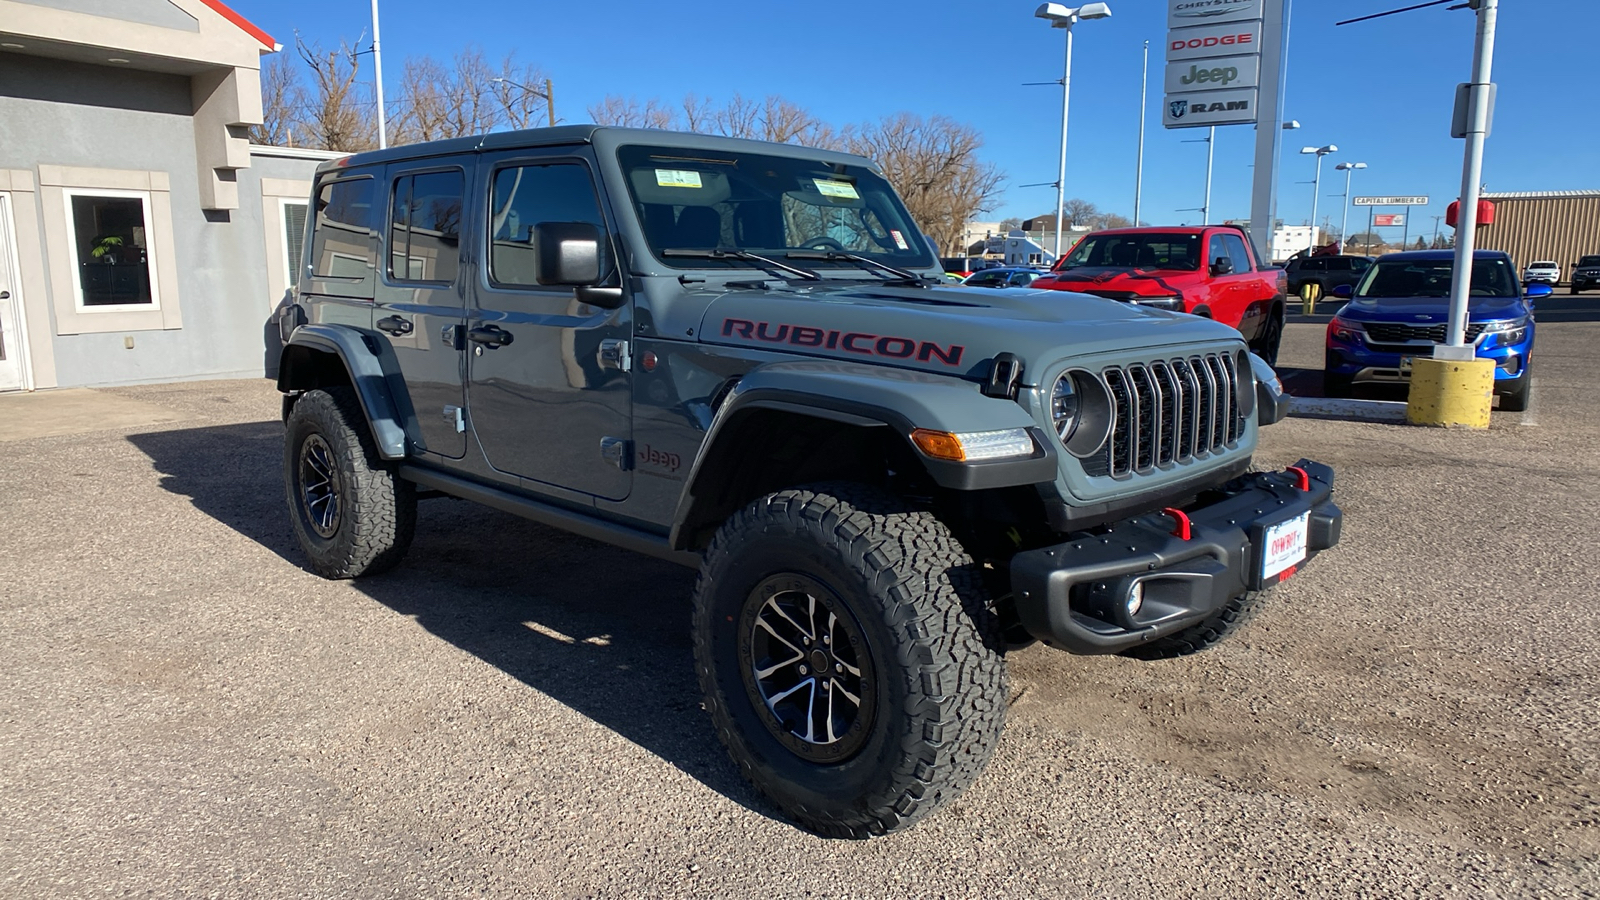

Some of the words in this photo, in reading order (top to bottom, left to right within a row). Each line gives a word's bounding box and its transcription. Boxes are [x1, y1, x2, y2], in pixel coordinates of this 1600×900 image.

[1171, 33, 1252, 50] DODGE
[1181, 65, 1238, 85] Jeep
[1191, 100, 1248, 113] RAM
[721, 318, 965, 367] RUBICON
[638, 443, 681, 473] Jeep
